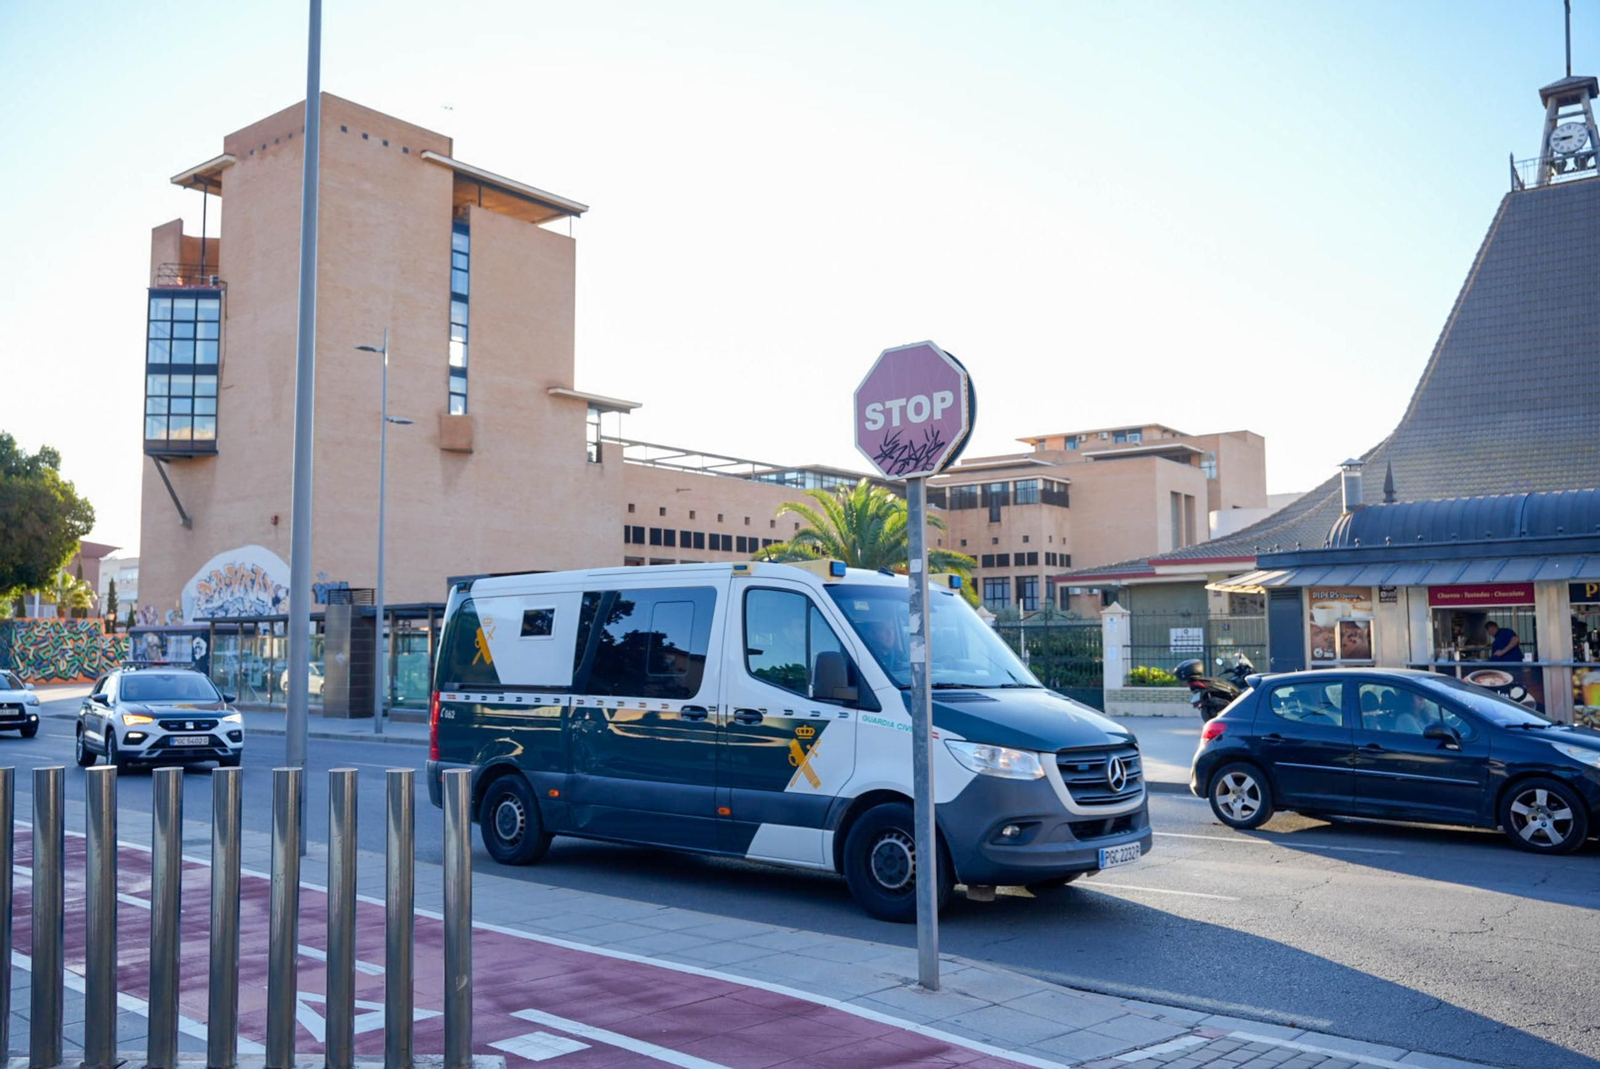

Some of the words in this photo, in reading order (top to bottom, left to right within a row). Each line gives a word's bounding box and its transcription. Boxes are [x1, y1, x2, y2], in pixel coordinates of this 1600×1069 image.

[864, 390, 954, 431] STOP
[1585, 583, 1600, 598] P
[862, 715, 895, 727] GUARDIA
[1105, 850, 1119, 865] PGC
